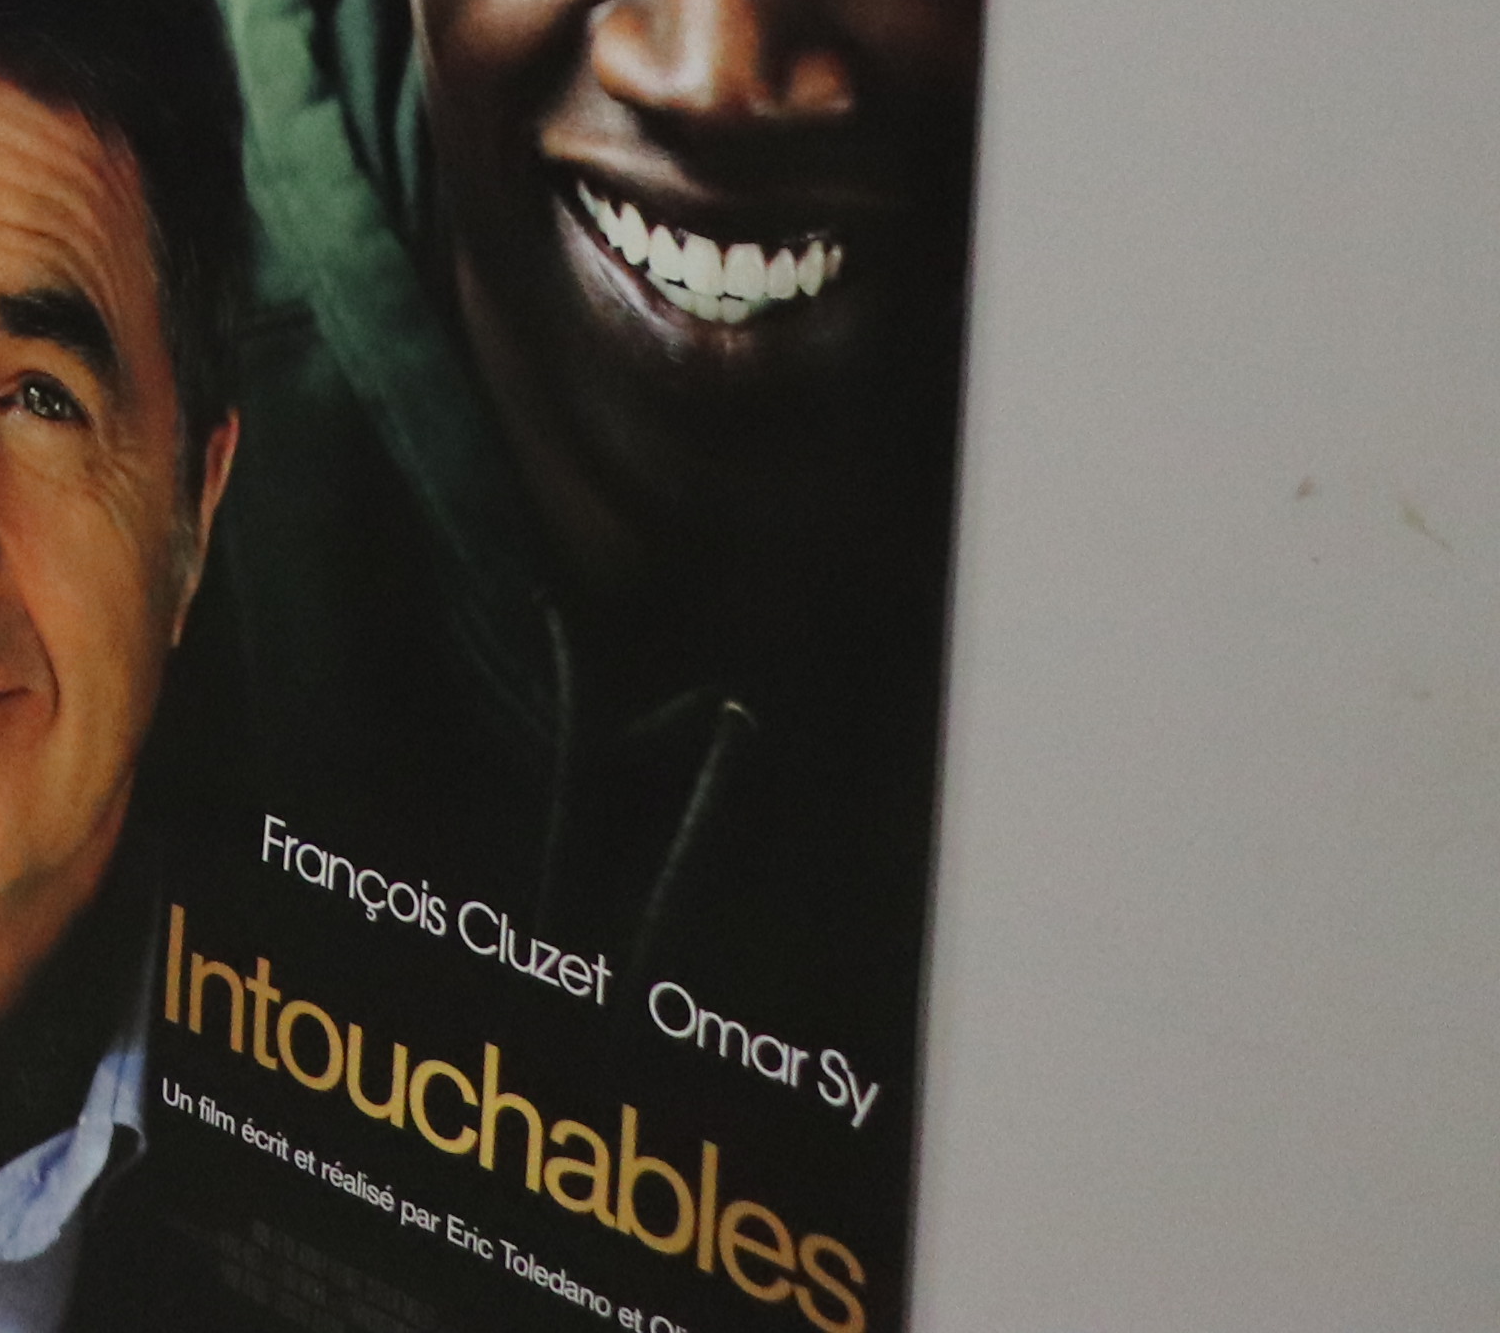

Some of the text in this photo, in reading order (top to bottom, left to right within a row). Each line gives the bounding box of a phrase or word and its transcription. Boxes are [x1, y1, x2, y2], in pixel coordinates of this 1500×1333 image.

[164, 903, 867, 1333] Intouchables
[261, 813, 880, 1129] François Cluzet Omar Sy
[162, 1077, 193, 1114] Un
[199, 1094, 236, 1136] film
[241, 1117, 290, 1163] écrit
[294, 1148, 317, 1176] et
[321, 1160, 396, 1213] réalisé
[400, 1198, 442, 1234] par
[446, 1213, 494, 1261] Eric
[499, 1239, 613, 1318] Toledano
[618, 1305, 644, 1333] et
